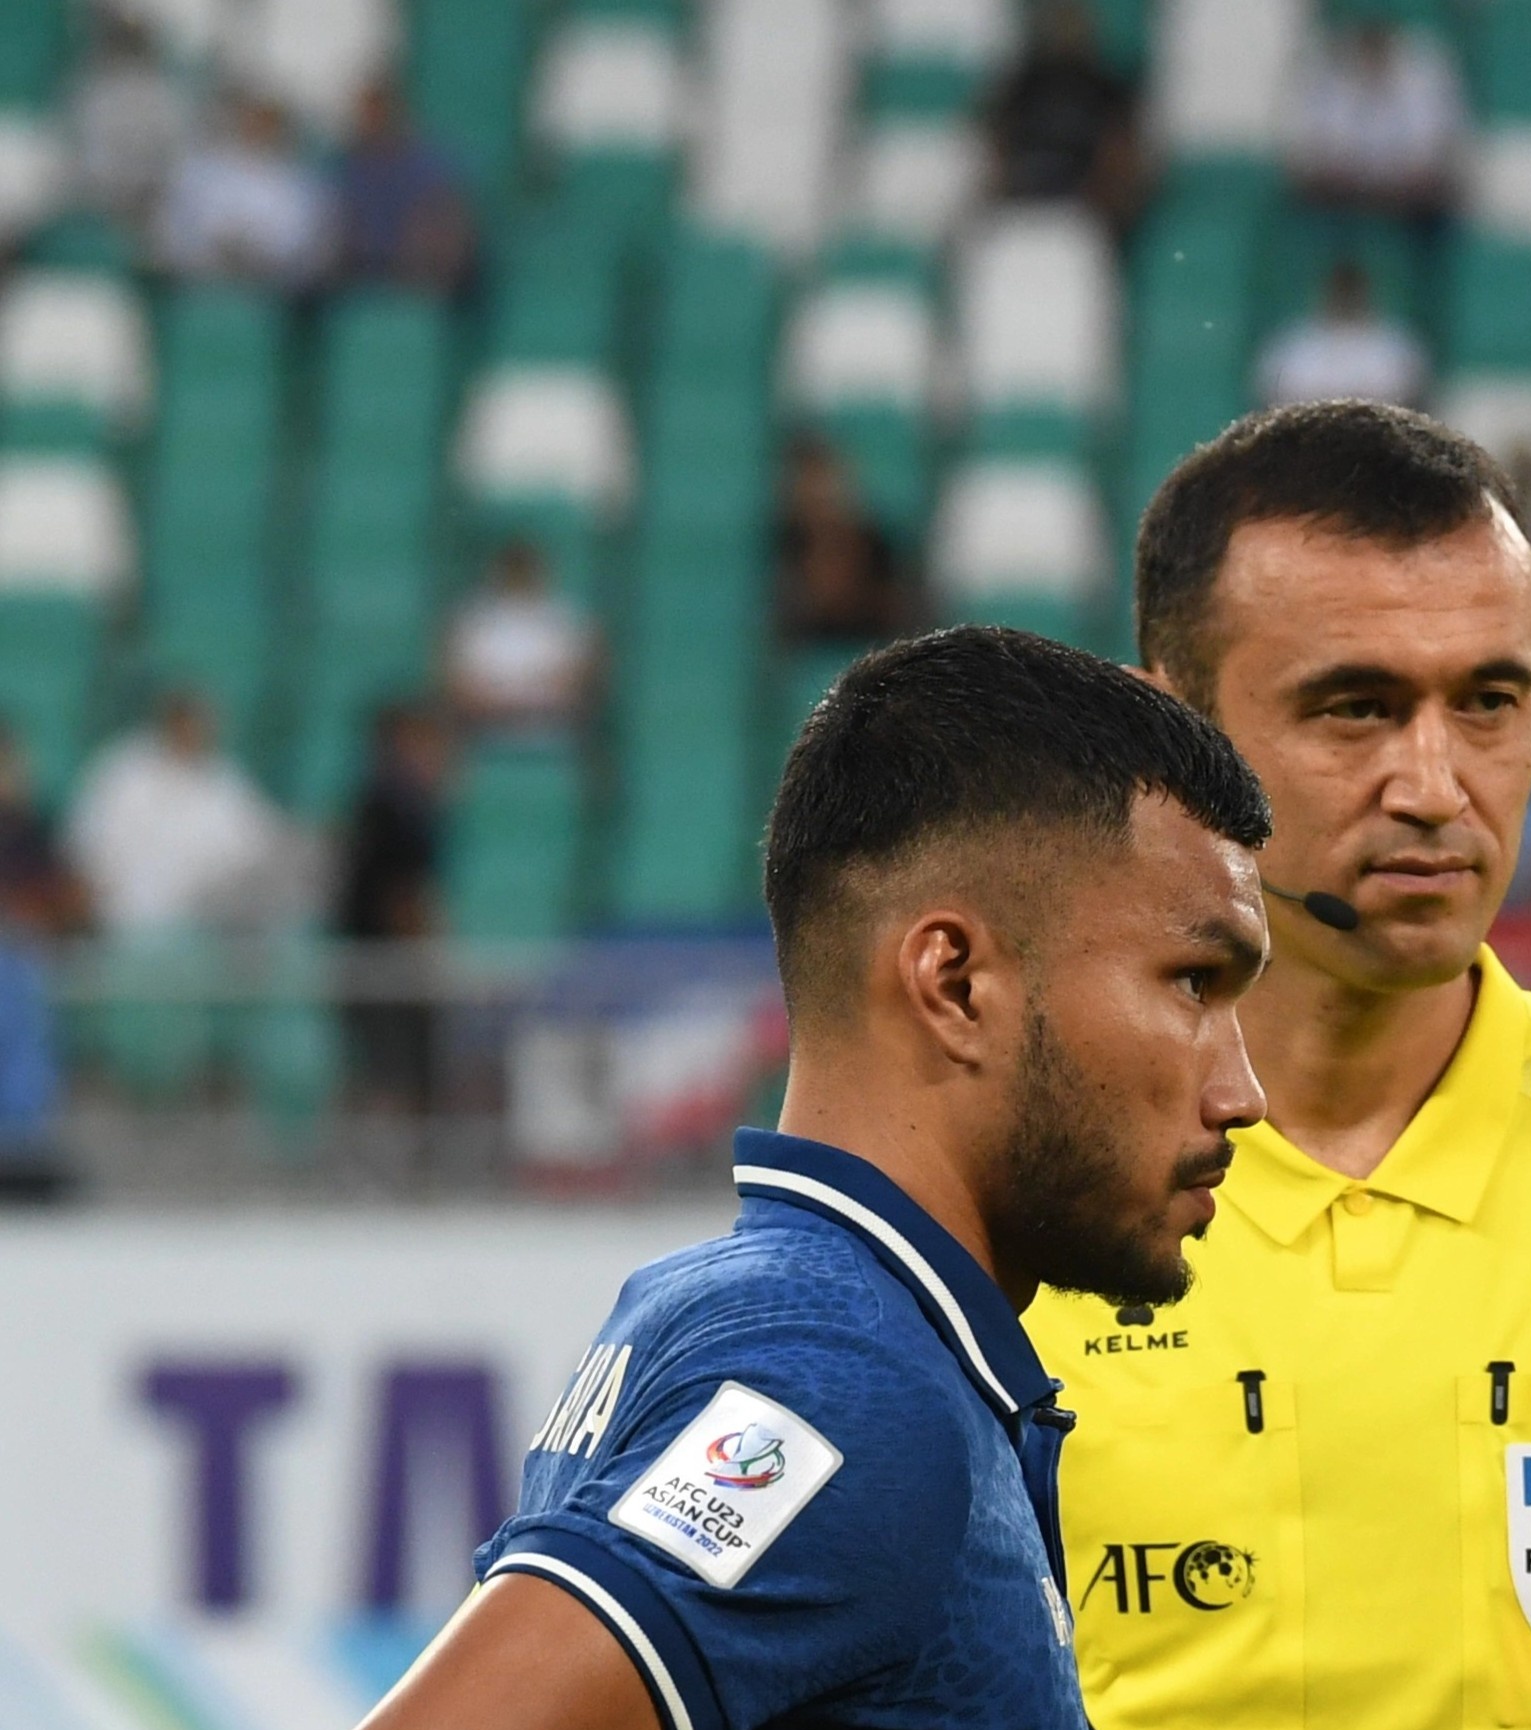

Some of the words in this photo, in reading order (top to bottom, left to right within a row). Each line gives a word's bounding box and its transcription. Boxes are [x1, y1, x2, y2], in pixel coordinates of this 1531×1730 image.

[1085, 1330, 1189, 1356] KELME
[642, 1486, 703, 1522] ASIAN
[702, 1517, 743, 1548] CUP
[642, 1503, 698, 1539] UZBEKISTAN
[696, 1533, 724, 1558] 2022
[665, 1477, 708, 1503] AFC
[706, 1496, 744, 1529] U23
[1079, 1539, 1236, 1614] AFC
